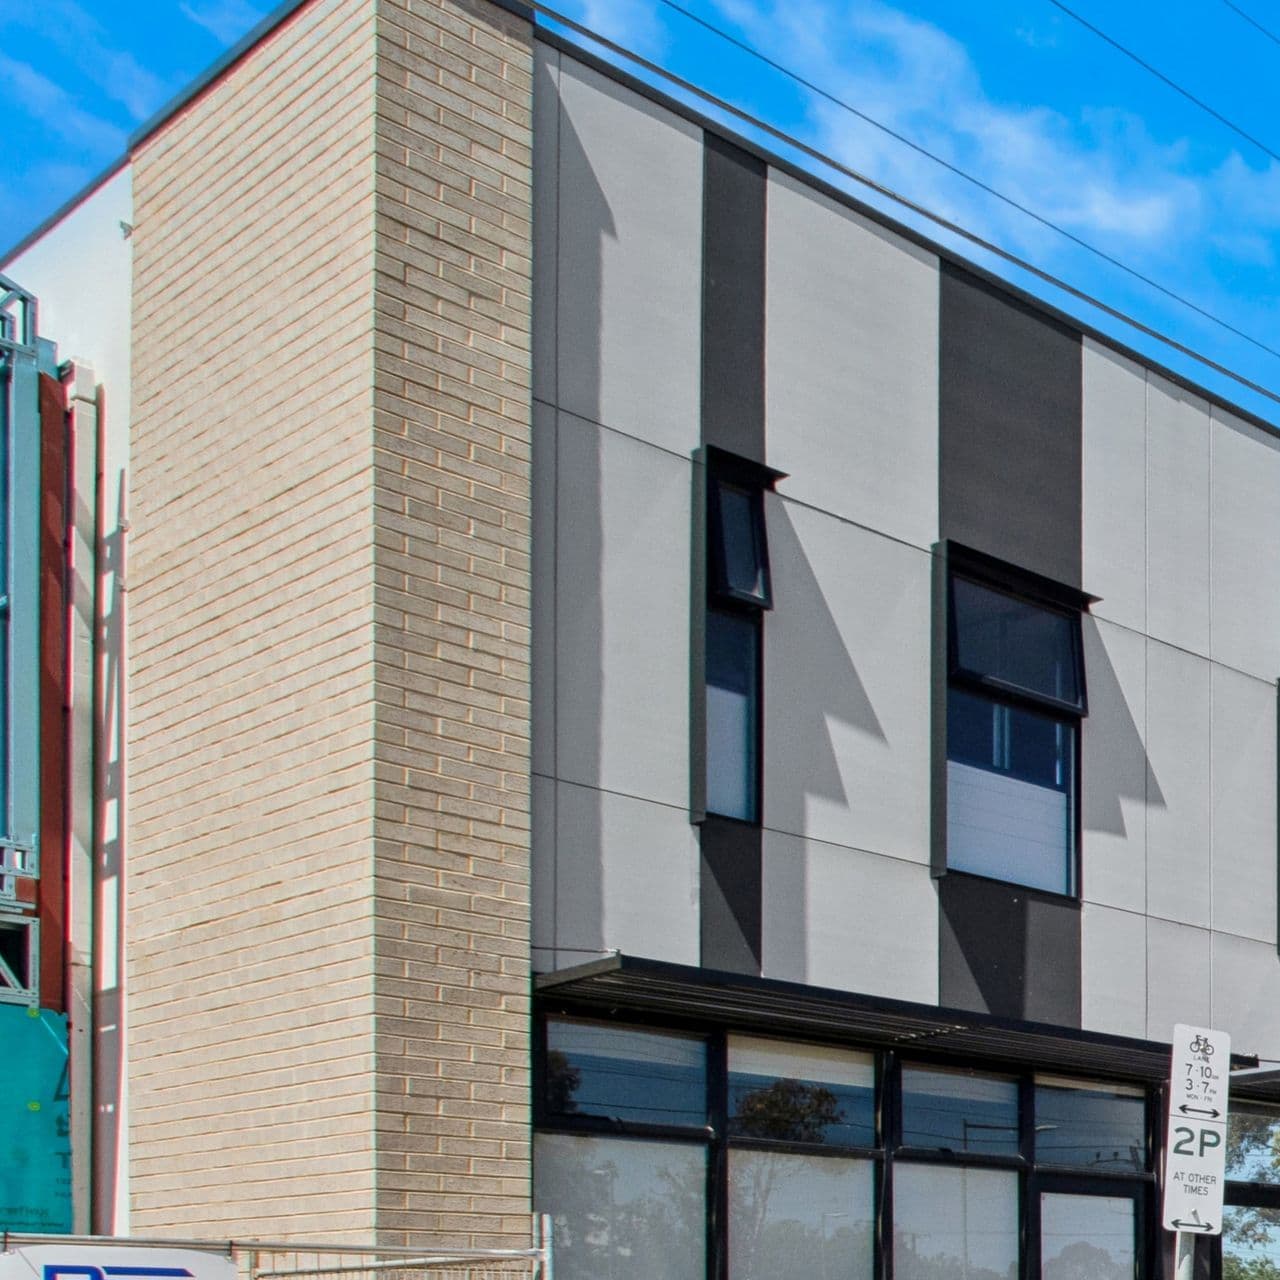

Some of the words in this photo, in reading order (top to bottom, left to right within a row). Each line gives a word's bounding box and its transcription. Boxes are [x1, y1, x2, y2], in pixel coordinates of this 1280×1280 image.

[1185, 1063, 1193, 1076] 7
[1185, 1078, 1193, 1091] 3
[1173, 1126, 1221, 1158] 2P
[1173, 1171, 1186, 1182] AT
[1188, 1174, 1217, 1185] OTHER
[1183, 1184, 1209, 1196] TIMES
